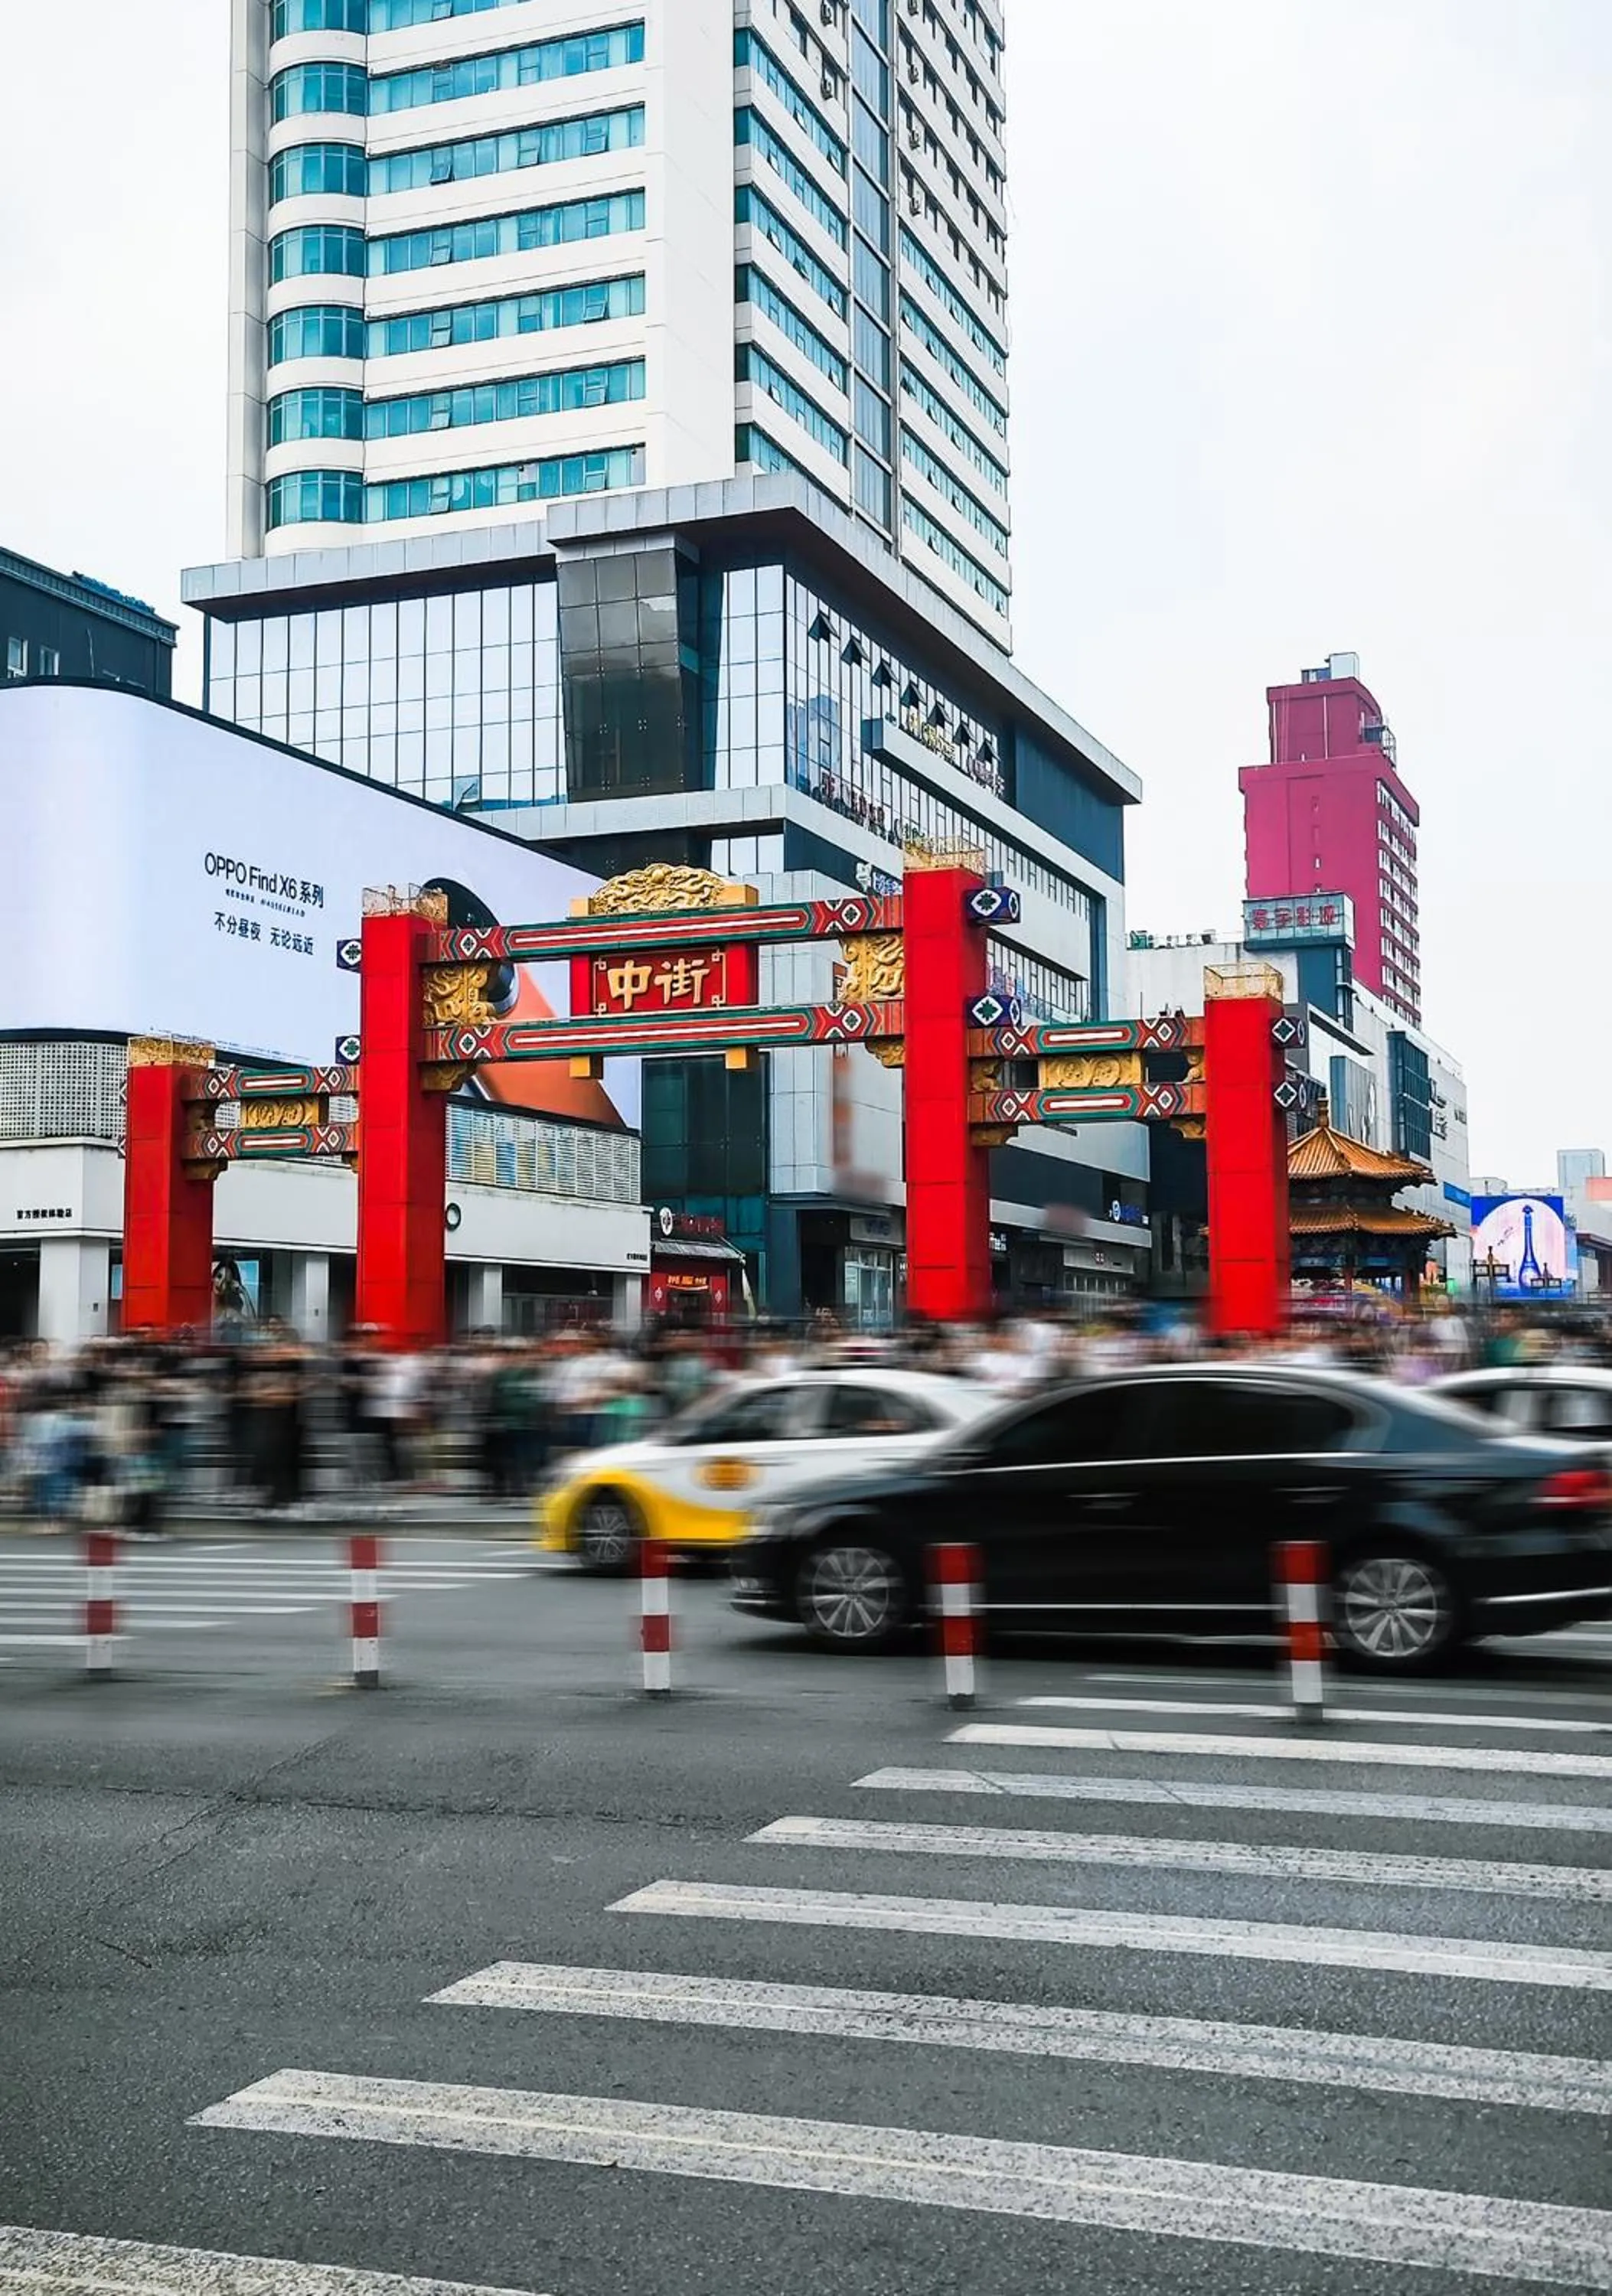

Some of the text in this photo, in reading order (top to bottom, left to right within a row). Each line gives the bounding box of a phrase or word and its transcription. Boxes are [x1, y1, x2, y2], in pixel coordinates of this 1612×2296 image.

[204, 852, 247, 885] OPPO
[249, 866, 278, 894] Find
[279, 875, 298, 900] X6
[299, 880, 325, 908] 系列
[214, 912, 314, 956] 不分昼夜 无论远近
[607, 958, 710, 1010] 中街
